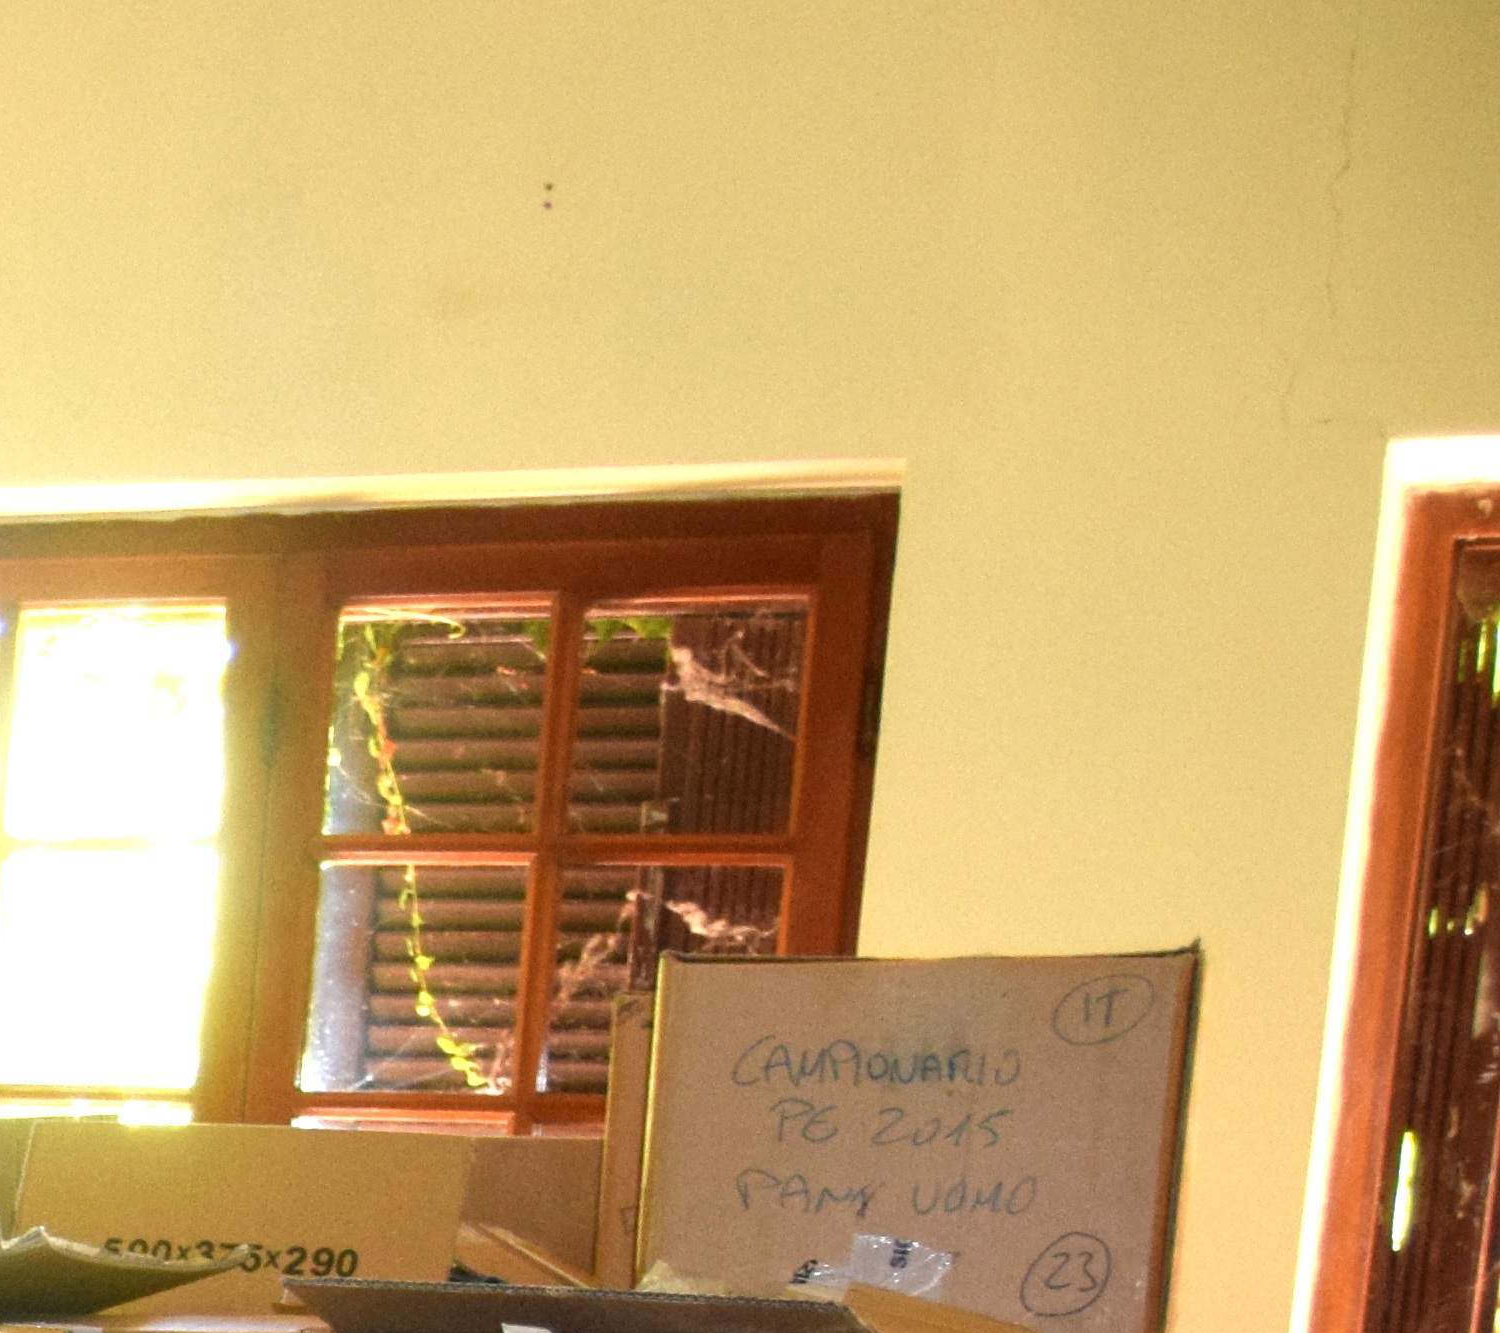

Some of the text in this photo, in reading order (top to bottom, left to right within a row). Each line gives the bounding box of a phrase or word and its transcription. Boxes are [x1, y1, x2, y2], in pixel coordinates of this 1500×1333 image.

[732, 1035, 1021, 1087] CAMPIONARIO
[770, 1098, 1012, 1148] PE 2015
[911, 1175, 1038, 1217] UOMO
[1043, 1251, 1098, 1293] 23
